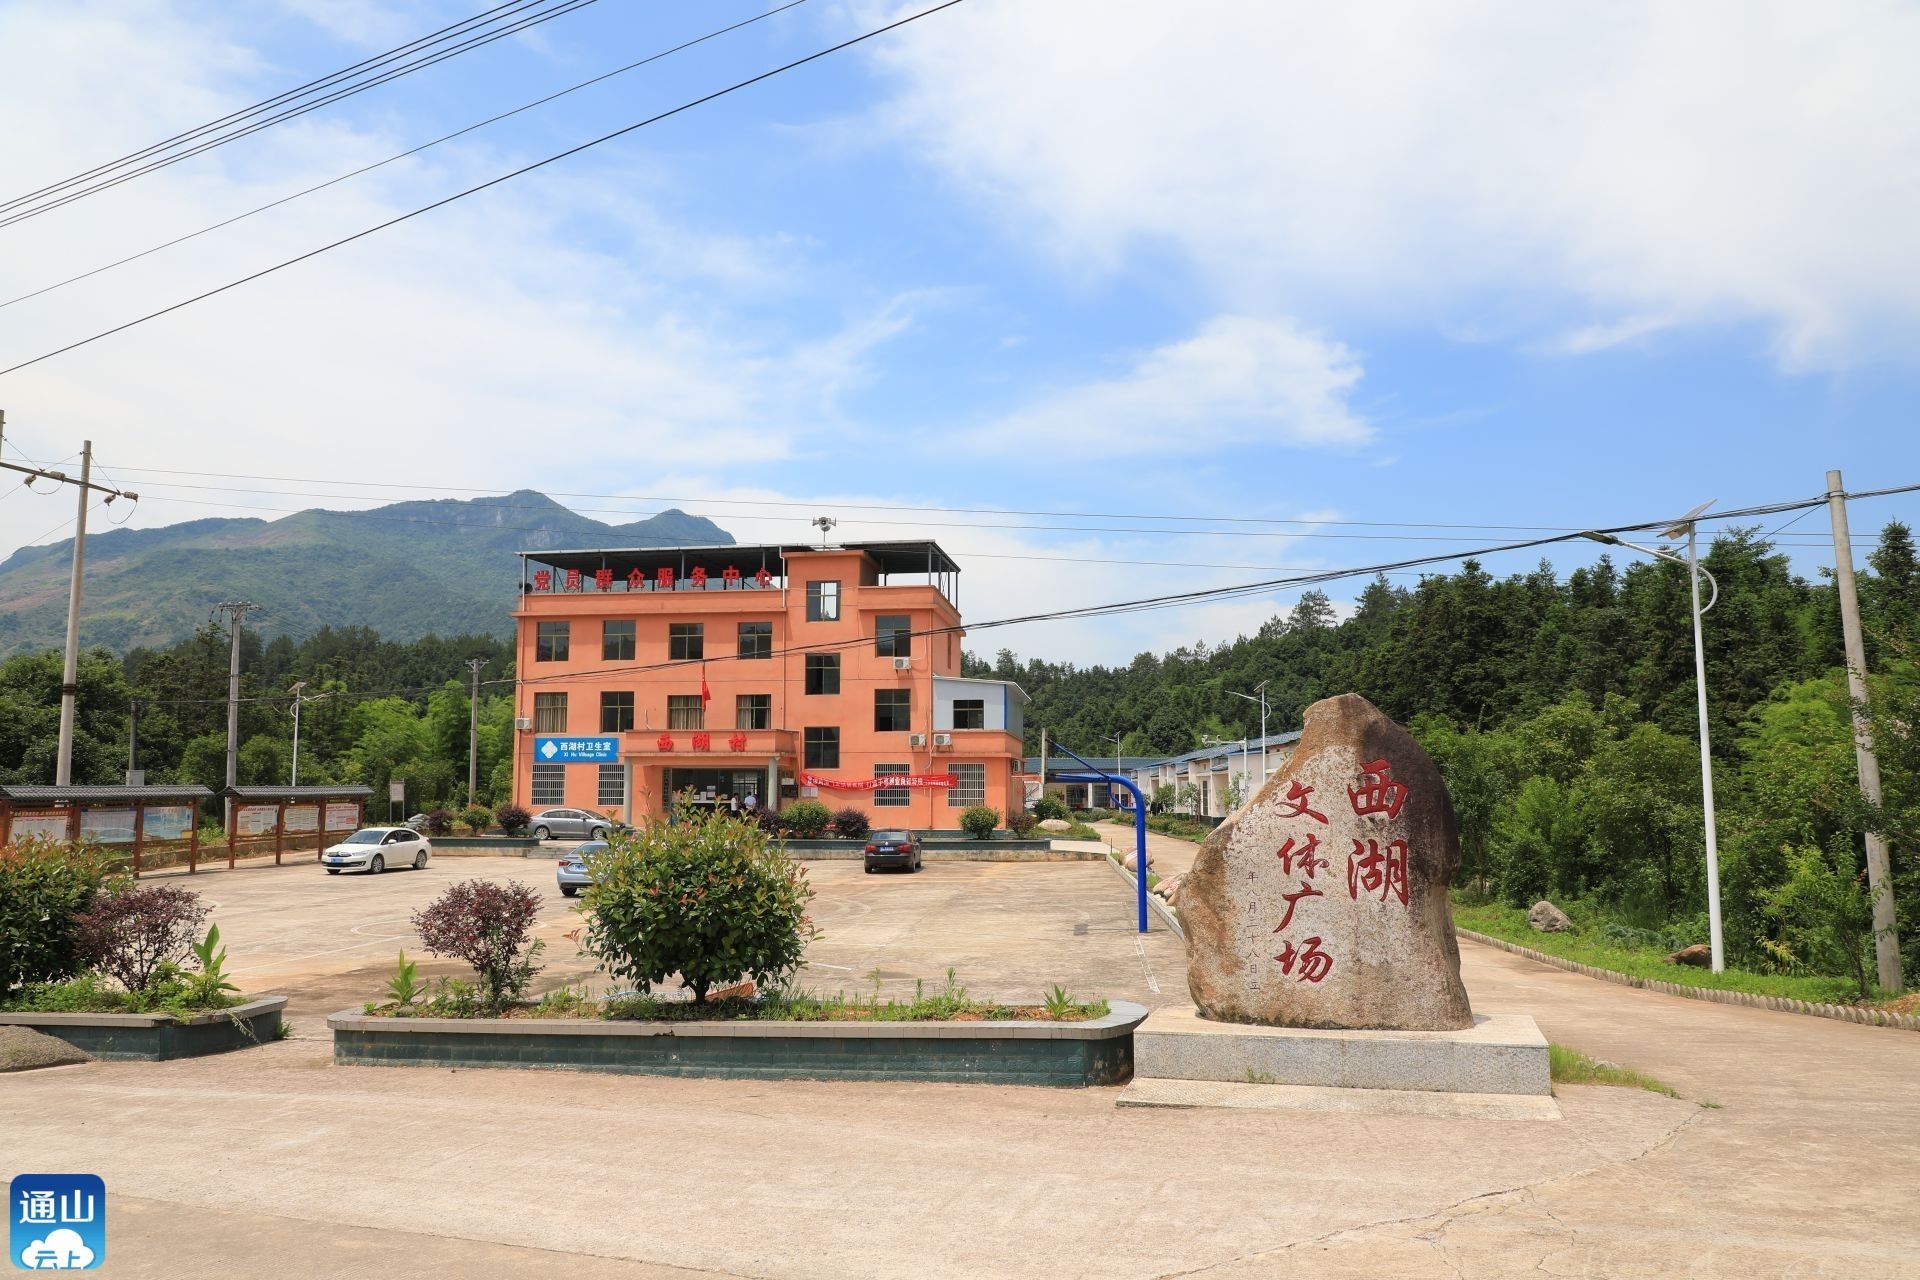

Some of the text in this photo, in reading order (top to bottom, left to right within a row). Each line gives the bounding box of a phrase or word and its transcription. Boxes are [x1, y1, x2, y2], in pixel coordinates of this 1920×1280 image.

[533, 566, 773, 590] 党员群众服务中心
[560, 741, 611, 751] 西湖村卫生室
[657, 731, 747, 752] 西湖村
[1347, 758, 1410, 907] 西湖
[1273, 780, 1334, 983] 文体广场
